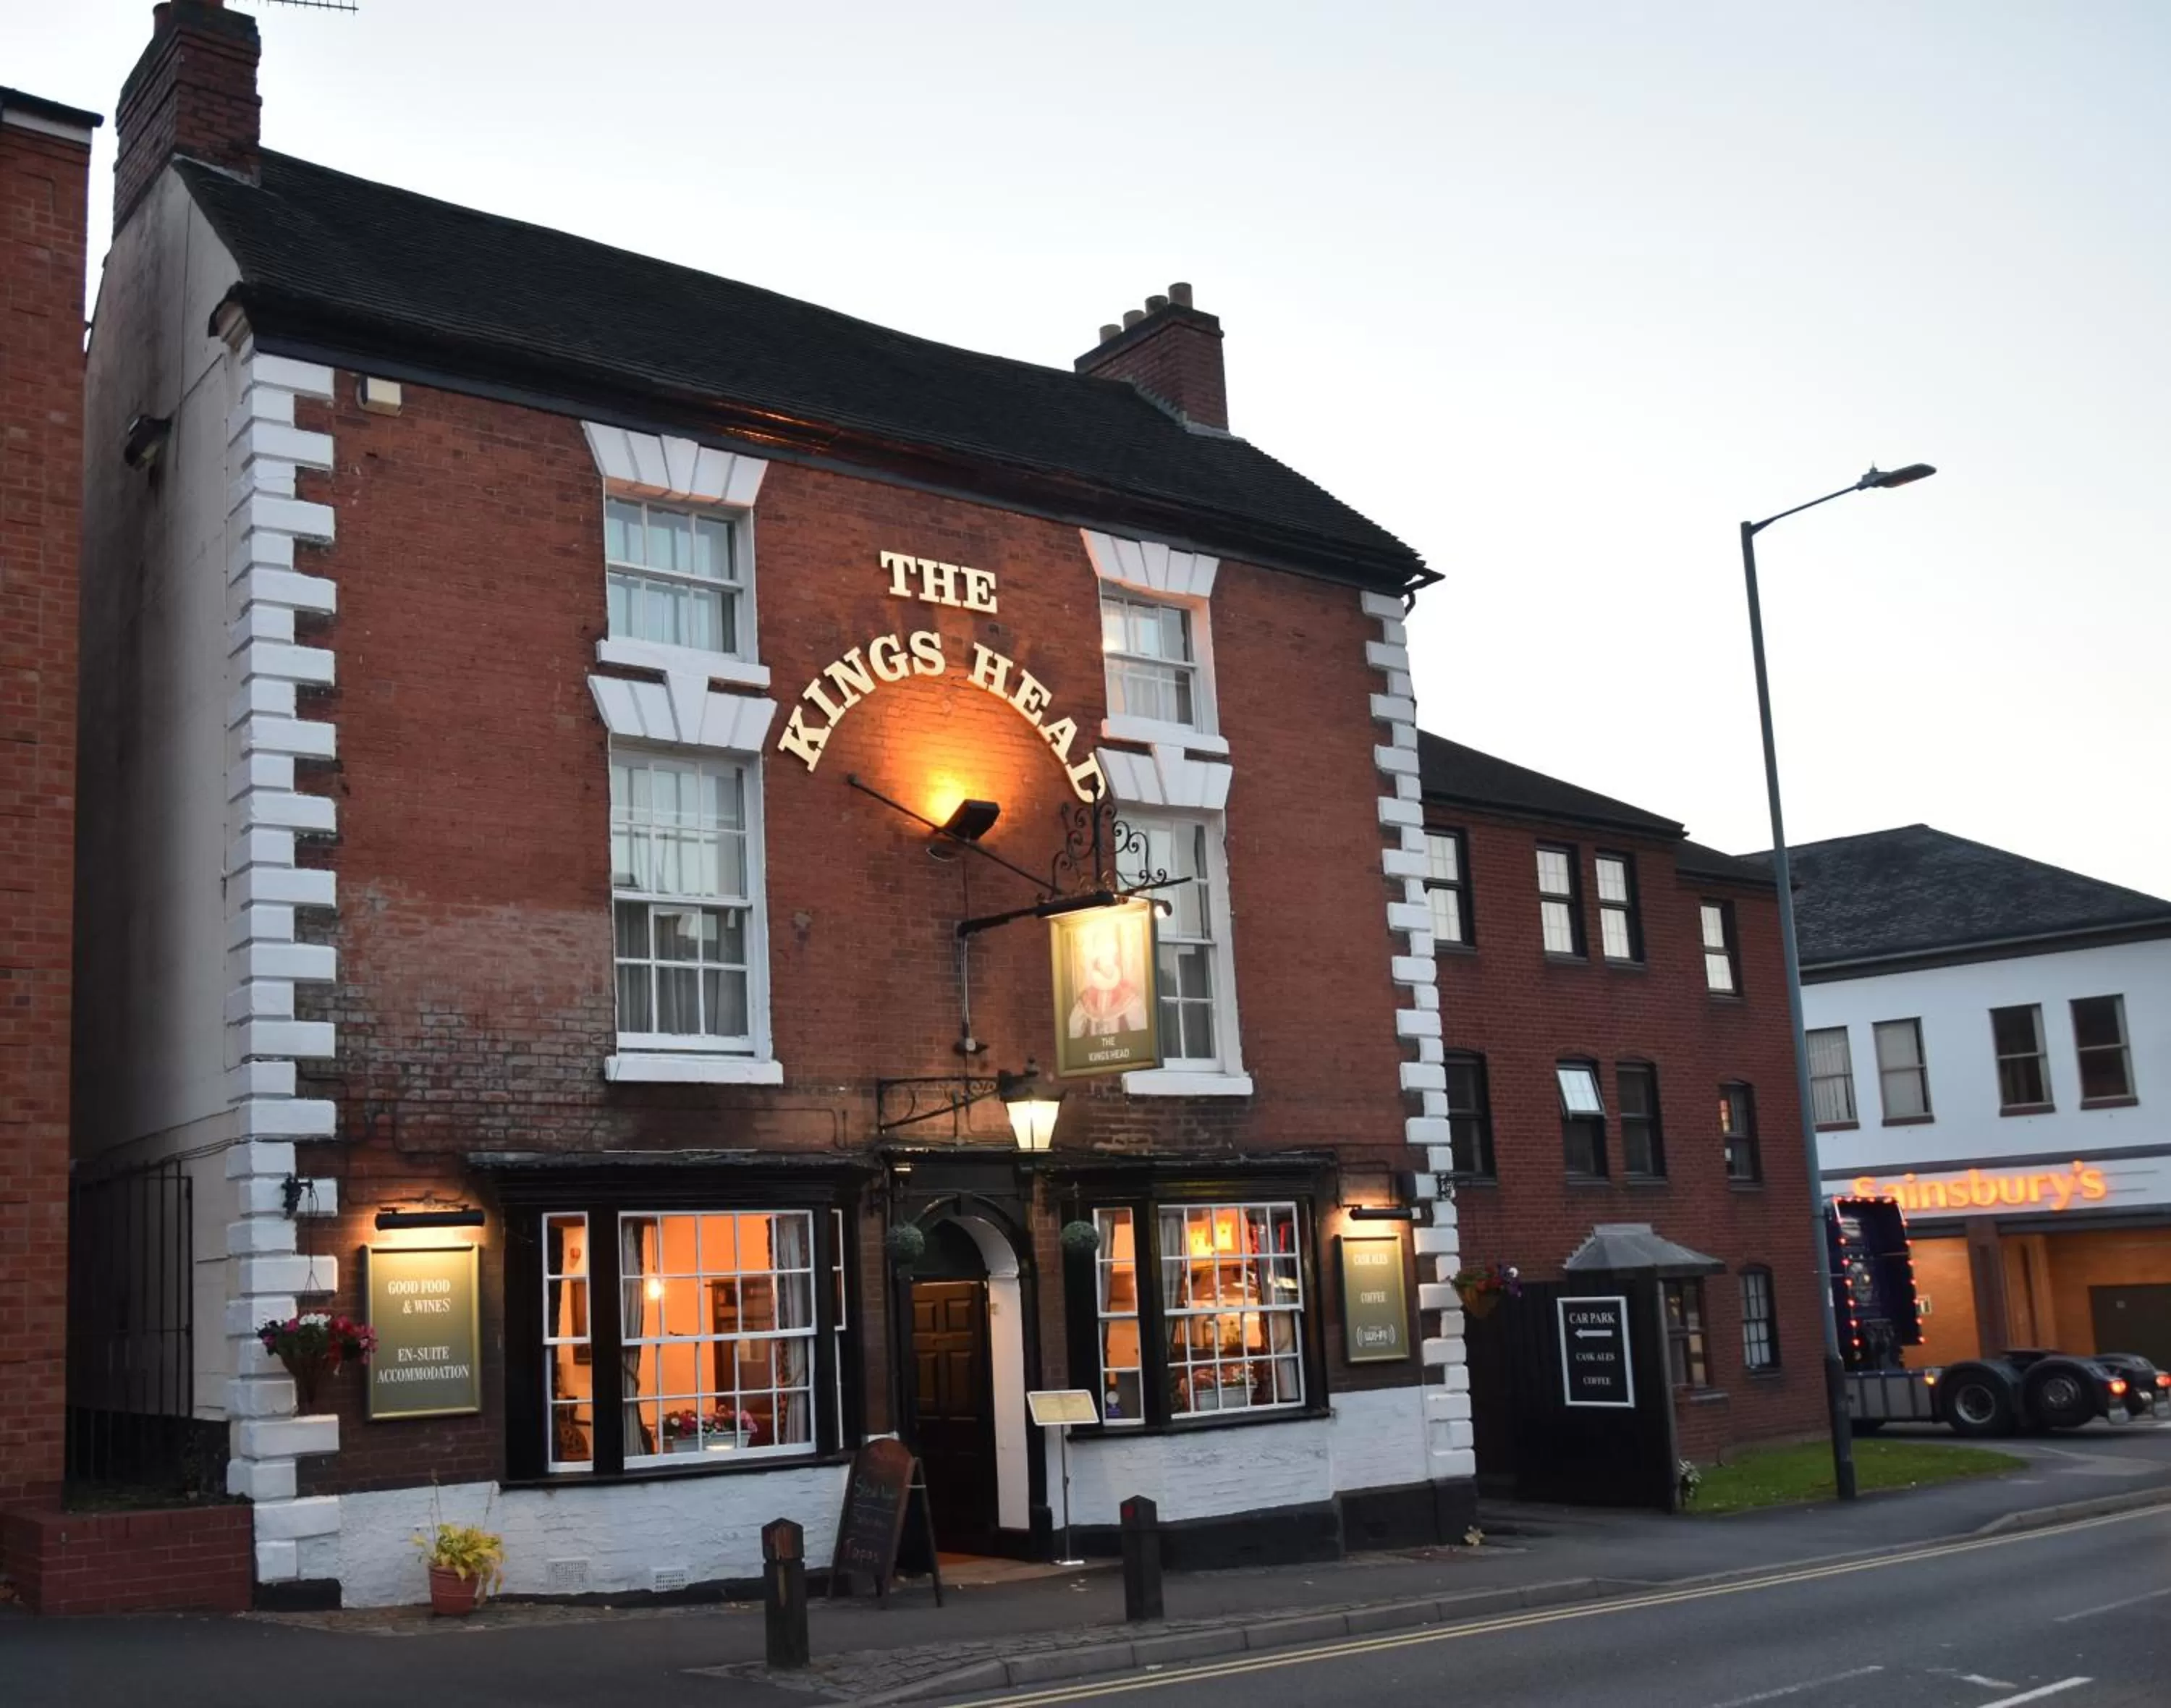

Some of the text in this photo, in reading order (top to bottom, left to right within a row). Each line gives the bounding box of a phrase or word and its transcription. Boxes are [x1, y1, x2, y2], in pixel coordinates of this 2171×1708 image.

[880, 550, 998, 614] THE
[777, 630, 1106, 803] KINGS HEAD
[1101, 1036, 1115, 1047] THE
[388, 1279, 450, 1295] GOOD FOOD
[402, 1298, 451, 1314] & WINES
[1568, 1311, 1616, 1324] CAR PARK
[398, 1346, 450, 1362] EN-SUITE
[377, 1364, 470, 1383] ACCOMMODATION
